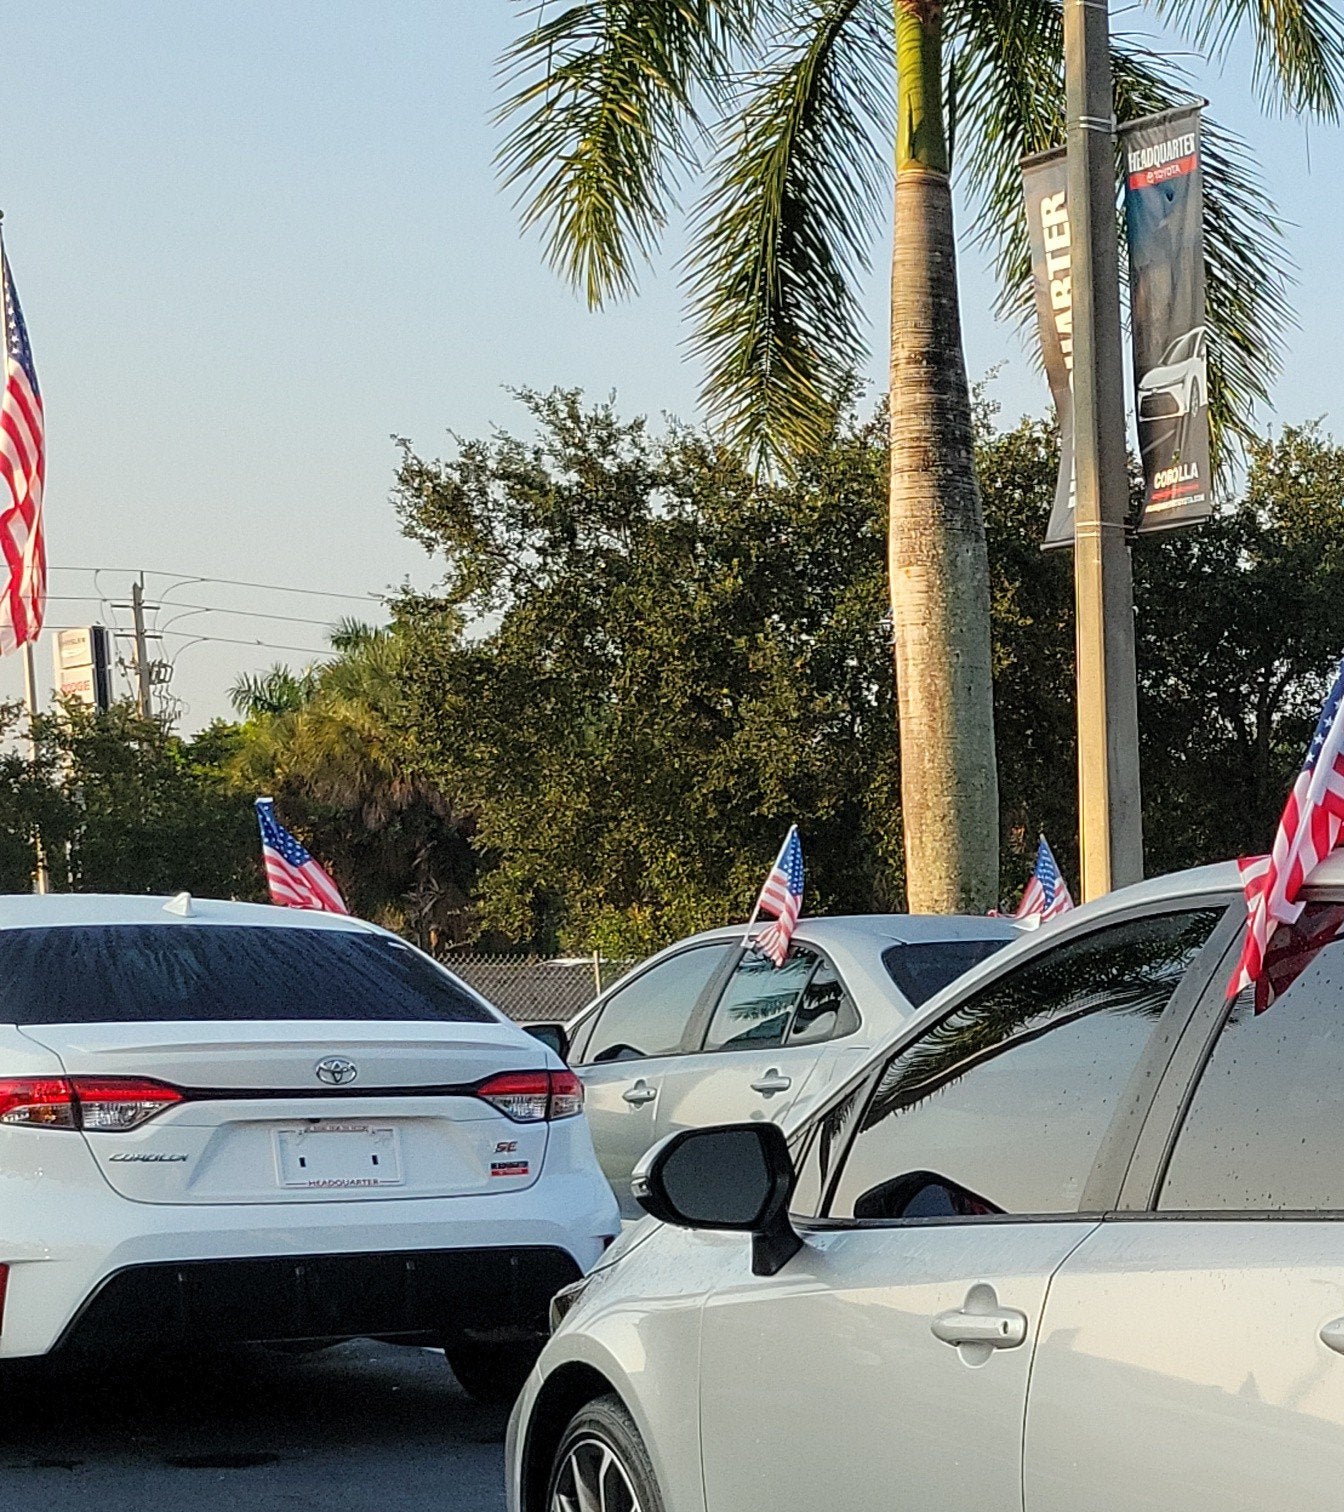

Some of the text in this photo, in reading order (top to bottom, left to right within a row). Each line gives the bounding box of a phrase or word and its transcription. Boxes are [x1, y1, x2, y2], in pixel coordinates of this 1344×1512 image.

[1154, 462, 1199, 489] COROLLA
[494, 1141, 518, 1154] SE
[308, 1179, 379, 1188] HEADQUARTER
